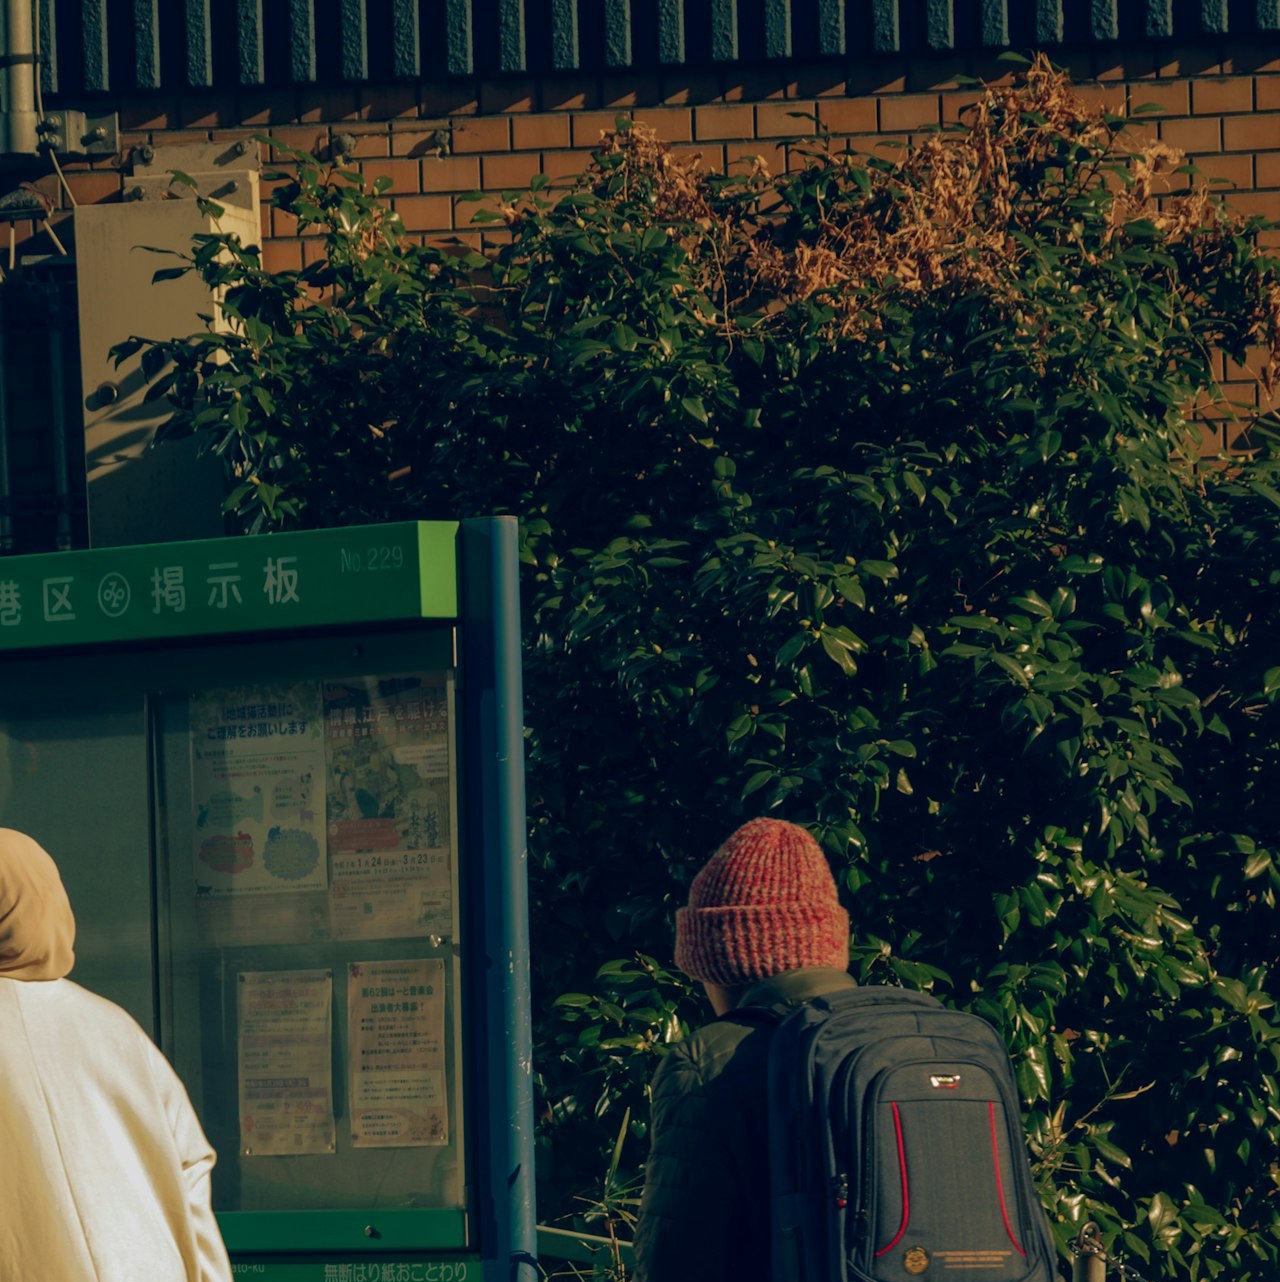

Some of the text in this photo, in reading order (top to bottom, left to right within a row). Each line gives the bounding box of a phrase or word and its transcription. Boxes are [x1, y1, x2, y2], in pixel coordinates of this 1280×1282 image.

[151, 555, 301, 615] 掲示板
[208, 720, 308, 740] ご理解をお願いします
